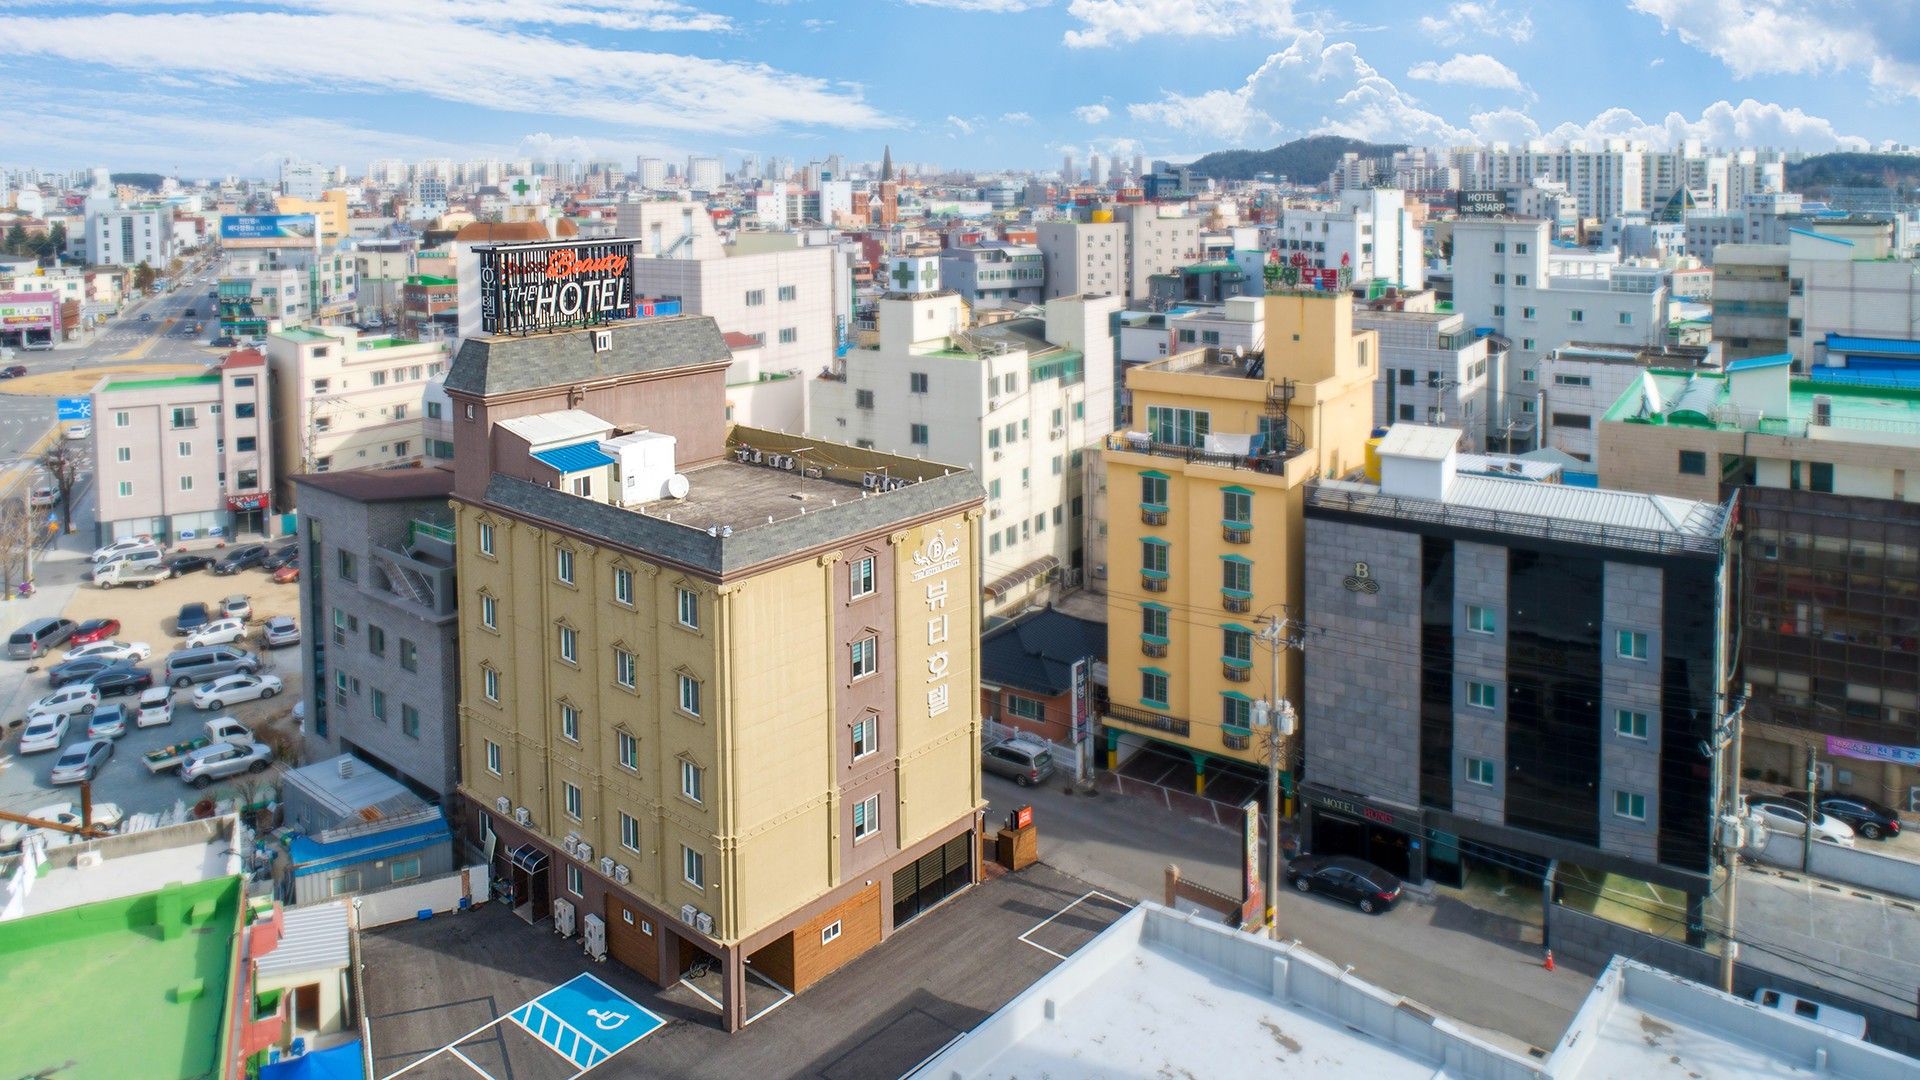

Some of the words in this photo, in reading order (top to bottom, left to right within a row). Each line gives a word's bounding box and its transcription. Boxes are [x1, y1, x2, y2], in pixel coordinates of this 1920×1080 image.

[1467, 193, 1499, 202] HOTEL
[1461, 205, 1474, 213] THE
[1475, 203, 1506, 212] SHARP
[546, 249, 628, 278] Beauty
[509, 285, 537, 302] THE
[535, 277, 630, 319] HOTEL
[1355, 561, 1369, 578] B
[925, 578, 949, 719] 뷰티호텔
[1323, 797, 1359, 816] MOTEL
